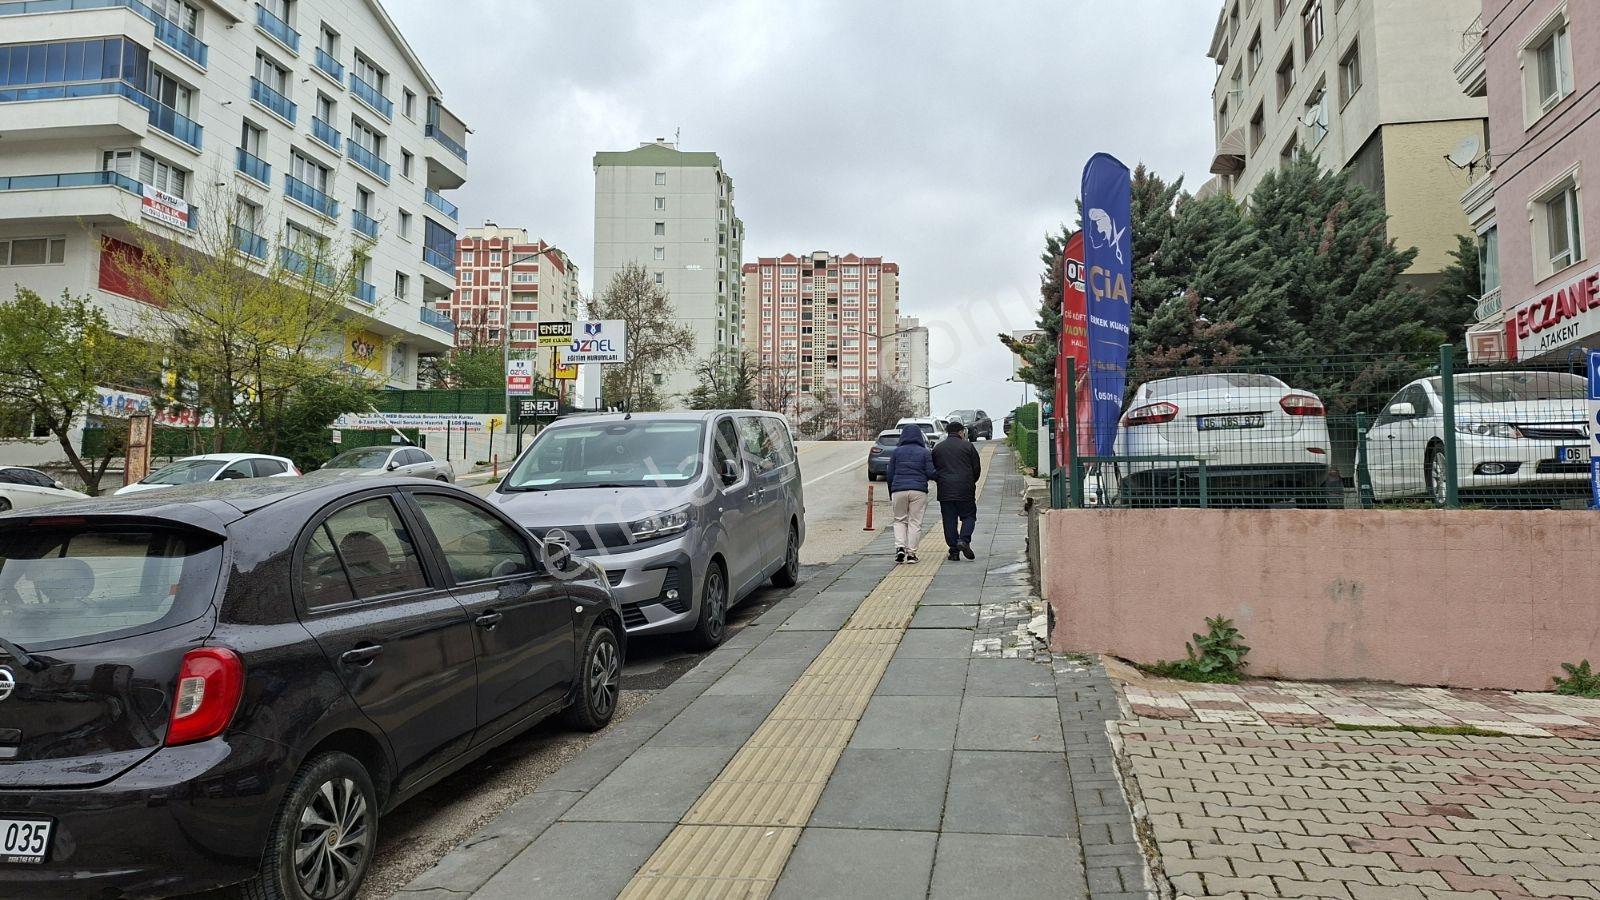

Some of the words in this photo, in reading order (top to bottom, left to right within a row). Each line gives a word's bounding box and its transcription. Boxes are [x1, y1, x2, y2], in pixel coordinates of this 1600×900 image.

[151, 200, 180, 218] SATILIK
[1517, 271, 1600, 340] ECZANE
[1090, 314, 1109, 328] ERKEK
[1540, 321, 1580, 350] ATAKENT
[570, 338, 616, 352] ÖZNEL
[1203, 417, 1216, 428] 06
[1566, 447, 1581, 460] 06
[4, 822, 47, 853] 035
